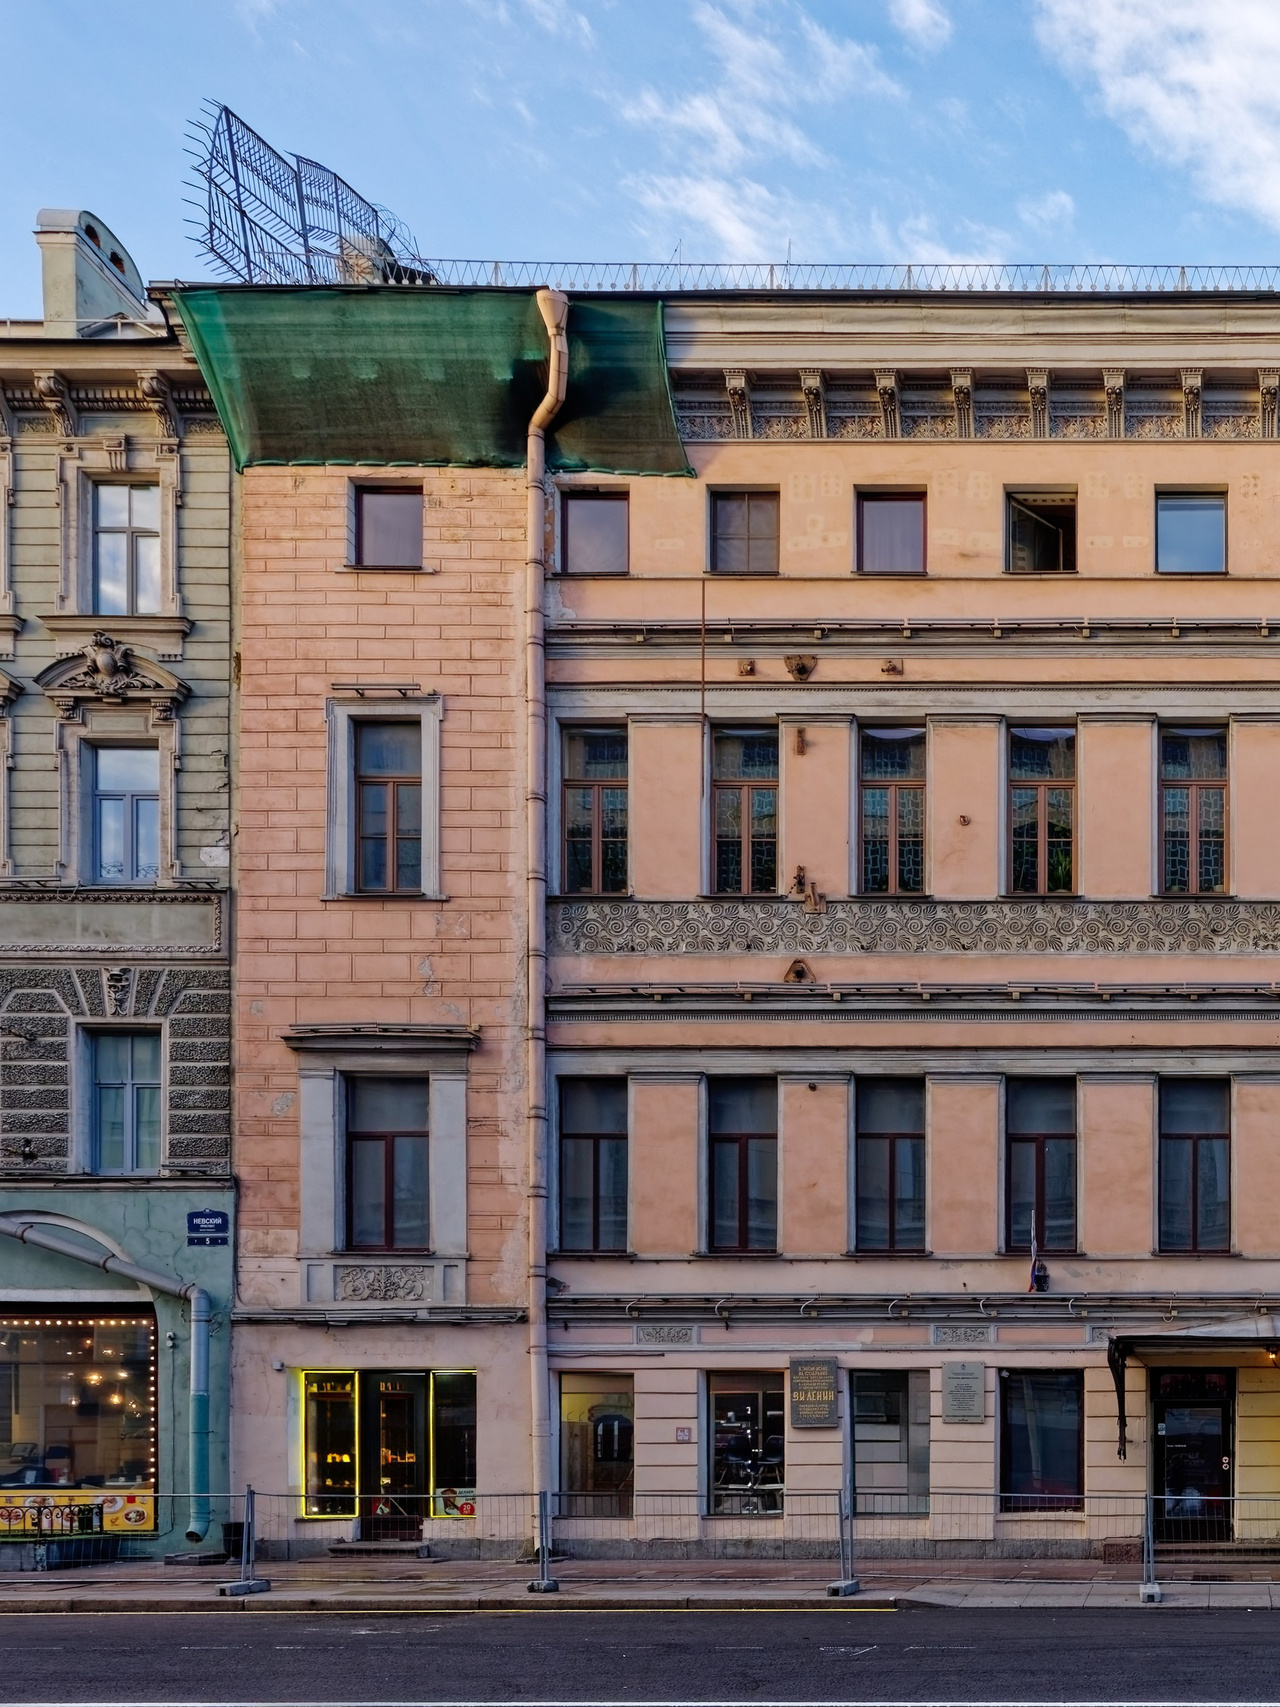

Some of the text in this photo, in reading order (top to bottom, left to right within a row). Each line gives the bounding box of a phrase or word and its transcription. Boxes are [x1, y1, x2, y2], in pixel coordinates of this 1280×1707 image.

[193, 1217, 222, 1225] НЕВСКИЙ
[205, 1237, 210, 1245] 5
[806, 1390, 835, 1401] ЛЕНИН
